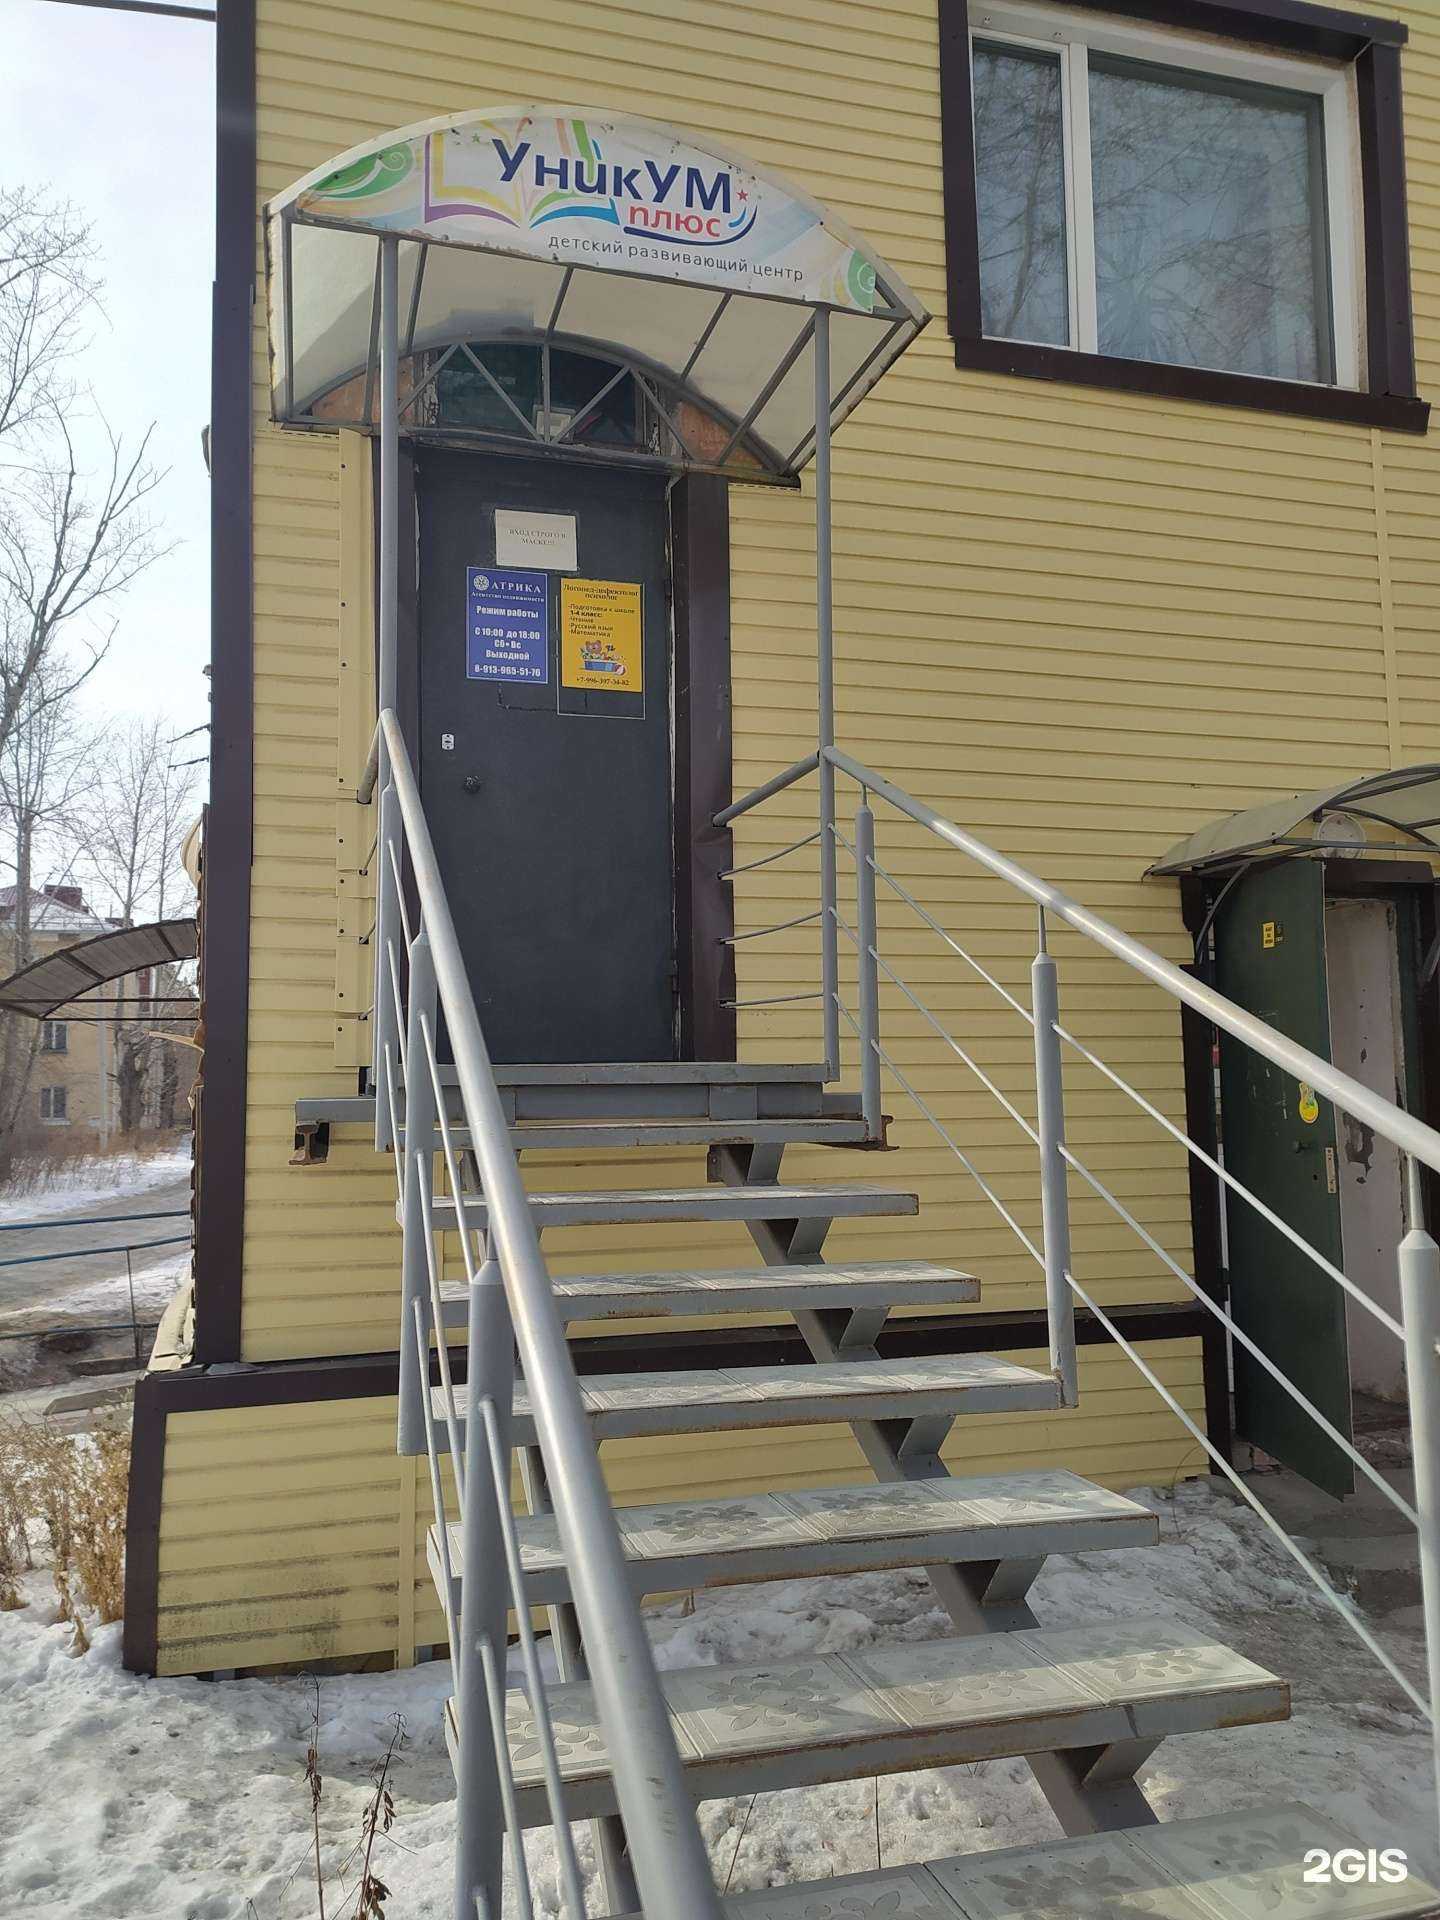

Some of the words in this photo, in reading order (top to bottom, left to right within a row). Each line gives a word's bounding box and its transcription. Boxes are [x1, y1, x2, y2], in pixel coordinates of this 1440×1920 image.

[628, 205, 722, 238] плюс
[548, 234, 624, 255] детский
[628, 243, 749, 274] развивающий
[752, 263, 804, 283] центр
[491, 580, 542, 593] АТРИКА
[475, 605, 507, 616] Режим
[507, 609, 540, 619] работы
[482, 627, 504, 637] 10:00
[506, 629, 518, 639] до
[519, 630, 541, 640] 18:00
[485, 649, 530, 661] Выходной
